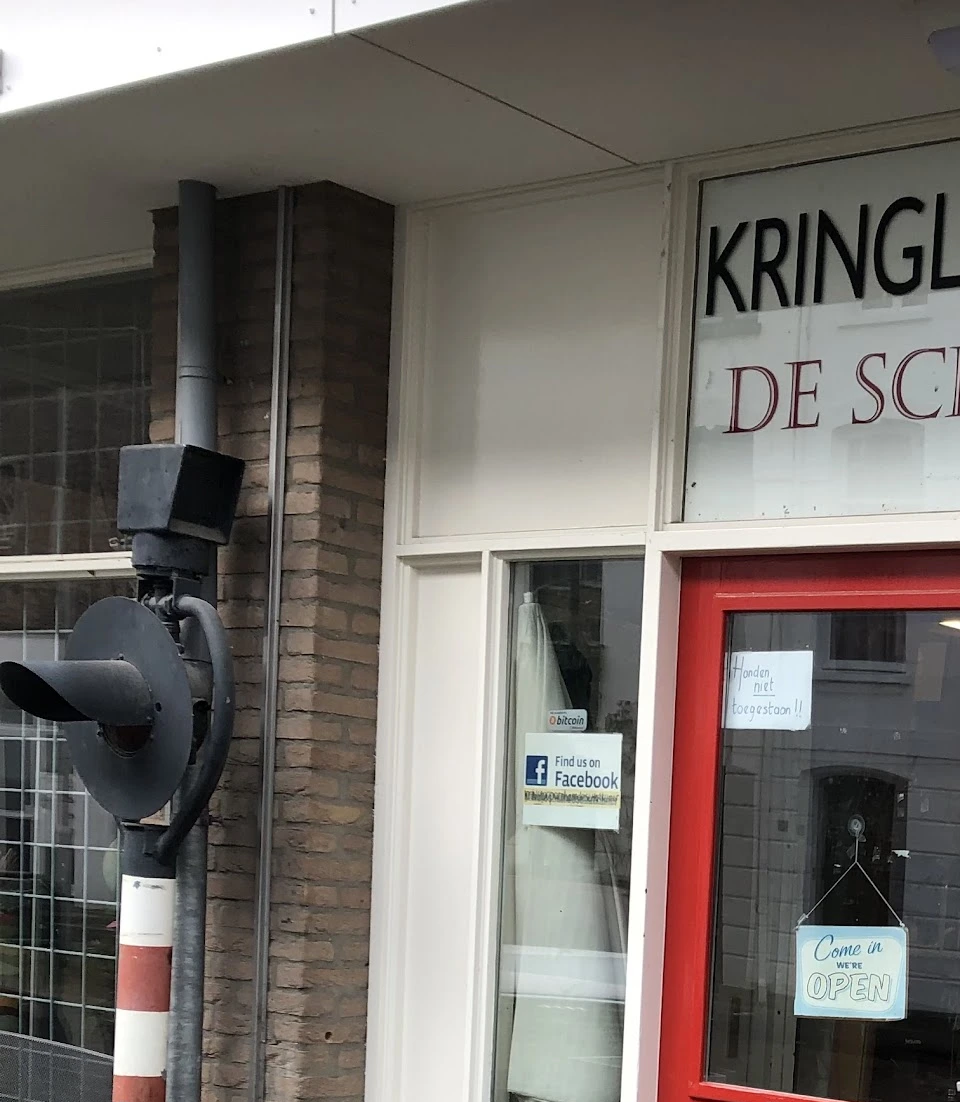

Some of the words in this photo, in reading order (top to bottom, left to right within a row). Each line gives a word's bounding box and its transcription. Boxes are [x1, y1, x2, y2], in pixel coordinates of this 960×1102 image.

[722, 359, 823, 434] DE
[754, 677, 774, 692] niet
[557, 716, 584, 725] bitcoin
[555, 756, 574, 767] Find
[577, 760, 586, 768] us
[590, 760, 600, 768] on
[555, 771, 618, 789] Facebook
[814, 934, 861, 961] Come
[868, 941, 883, 954] in
[807, 972, 890, 1001] OPEN
